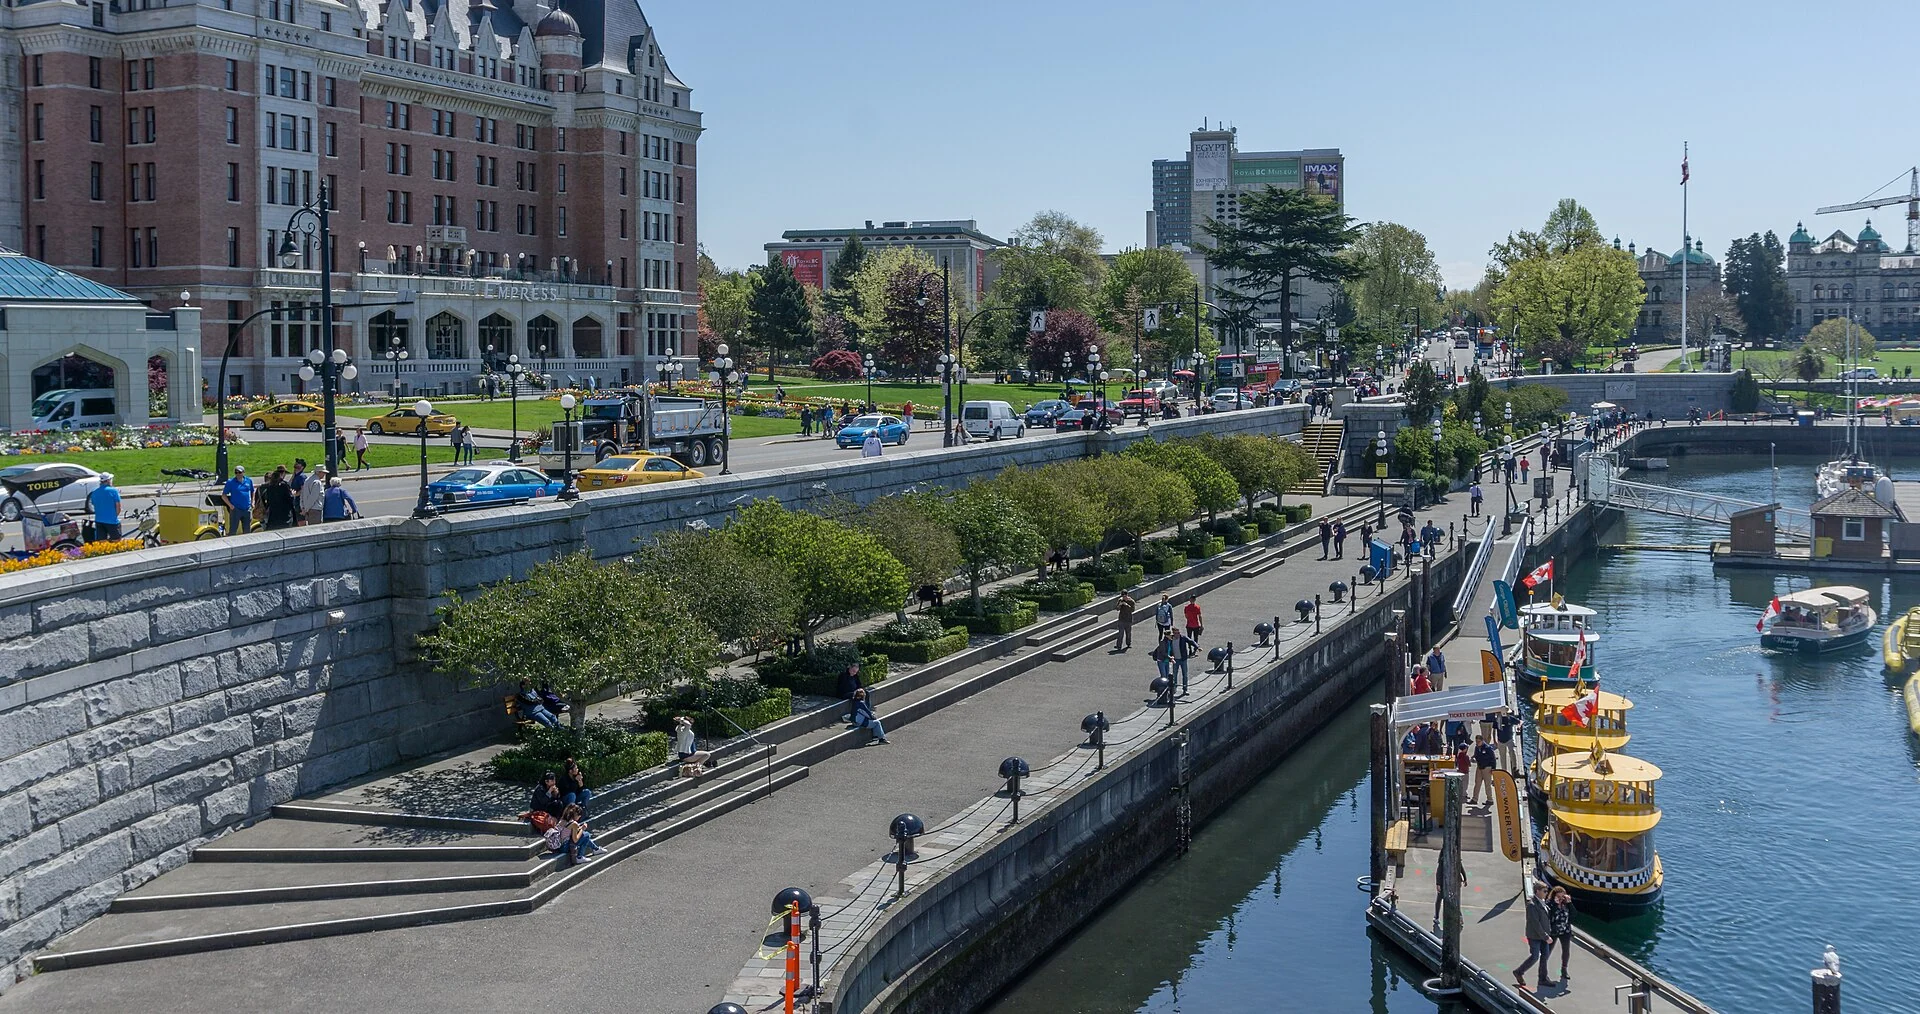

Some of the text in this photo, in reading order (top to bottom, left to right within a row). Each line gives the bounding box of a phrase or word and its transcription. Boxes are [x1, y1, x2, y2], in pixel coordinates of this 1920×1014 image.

[1195, 143, 1227, 152] EGYPT
[1305, 164, 1338, 173] IMAX
[452, 281, 558, 302] THE EMPRESS
[27, 480, 60, 491] TOURS
[1503, 797, 1512, 826] WATER
